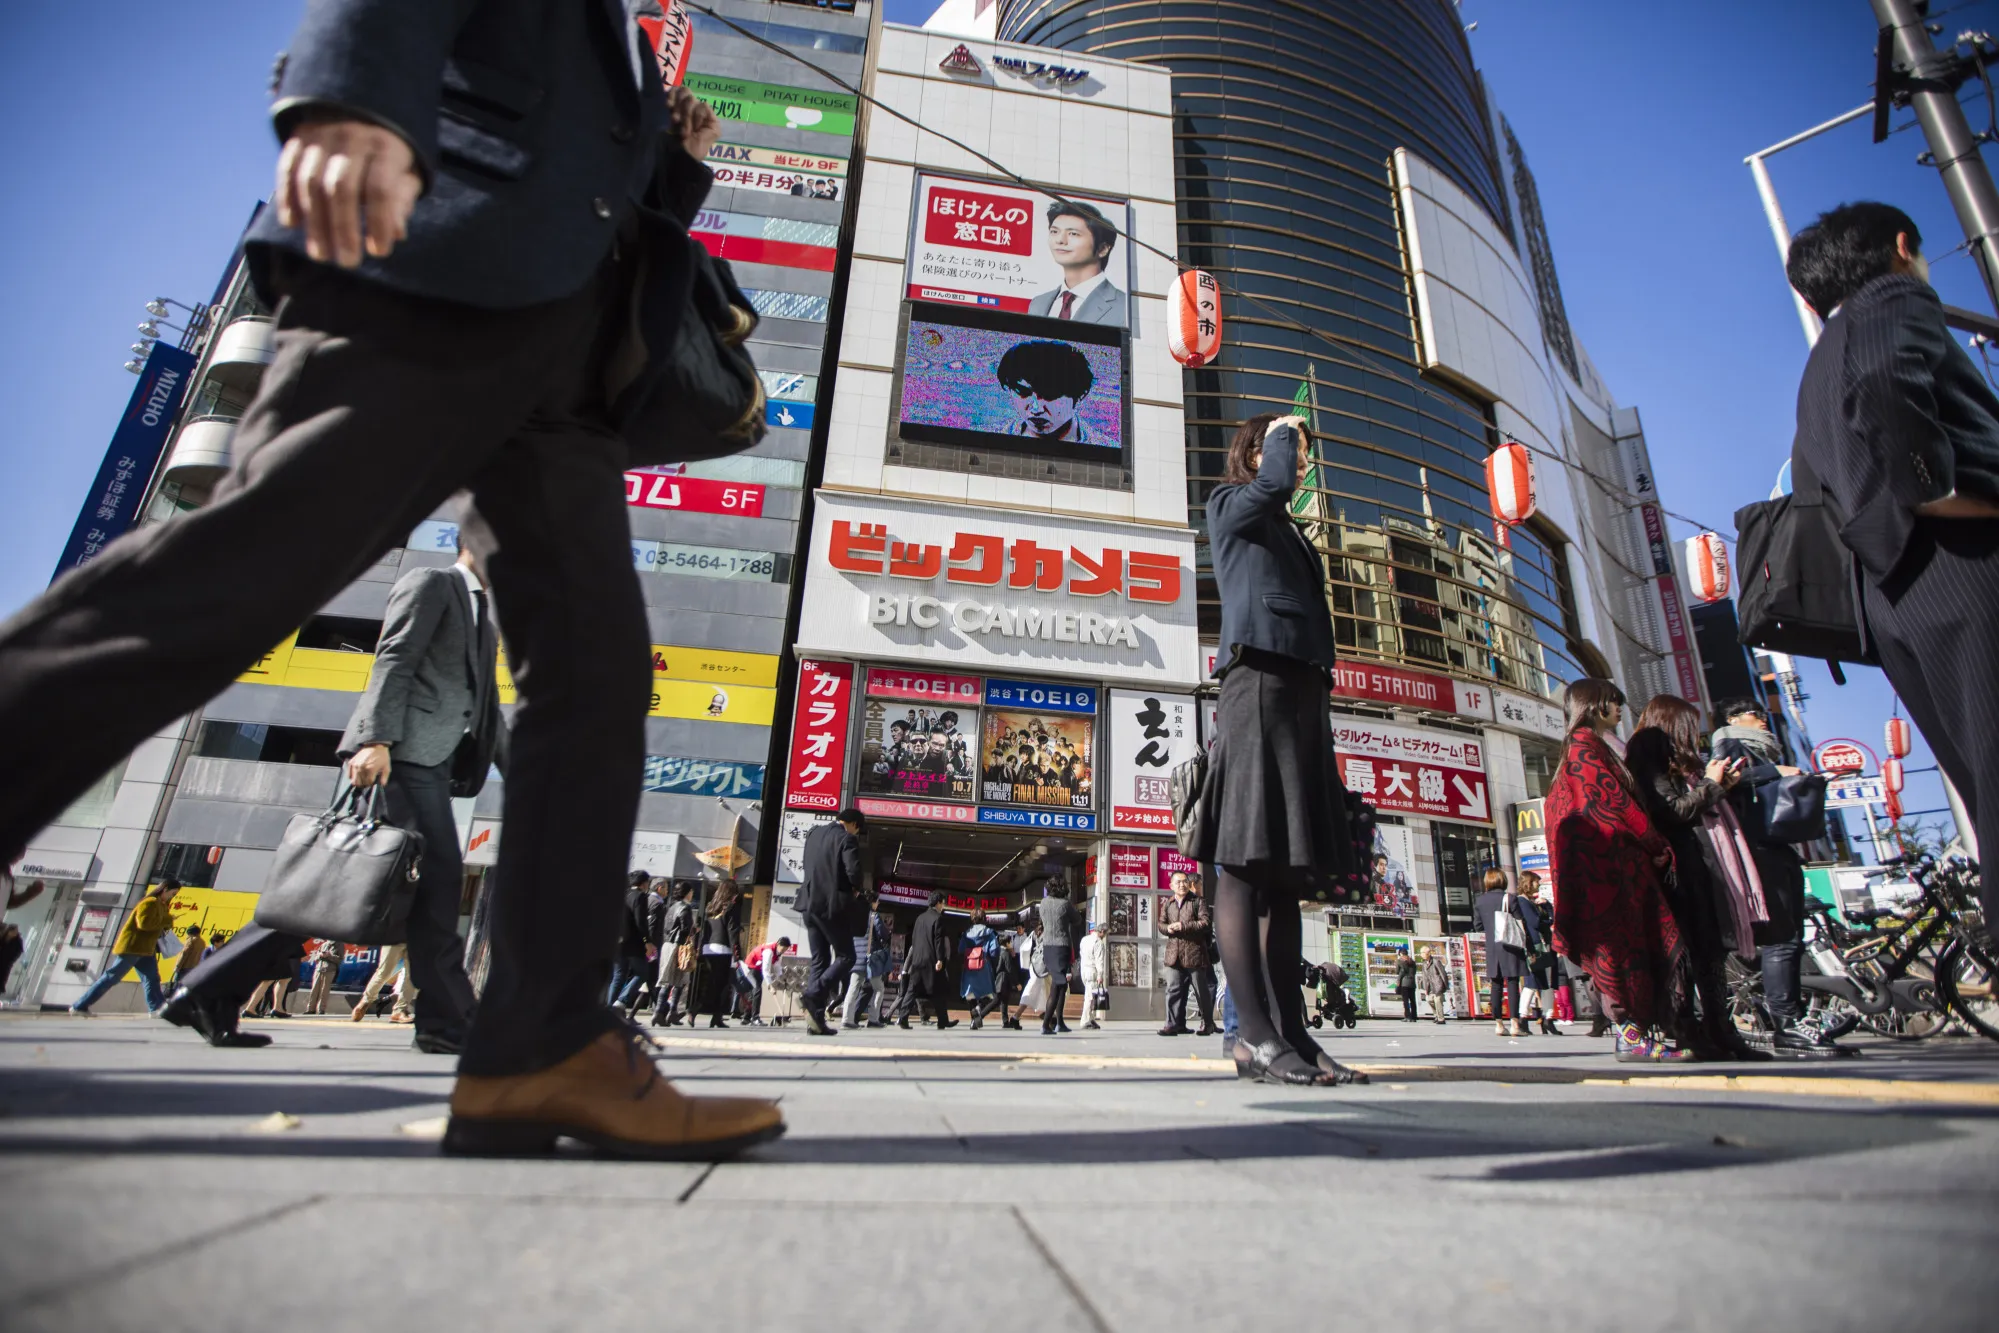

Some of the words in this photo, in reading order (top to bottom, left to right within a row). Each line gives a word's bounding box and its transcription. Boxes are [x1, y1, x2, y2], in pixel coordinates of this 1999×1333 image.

[697, 81, 746, 95] HOUSE
[763, 89, 800, 103] PITAT
[803, 94, 852, 110] HOUSE
[774, 154, 814, 168] 当ビル
[817, 160, 839, 170] 9F
[932, 196, 1029, 226] ほけんの
[953, 221, 1004, 246] 窓口
[923, 252, 1022, 272] あなたに寄り添う
[921, 264, 1038, 285] 保険選びのパートナー
[923, 290, 966, 301] ほけんの窓口
[141, 367, 181, 427] MIZUHO
[96, 456, 137, 521] みずほ証券
[720, 488, 759, 509] 5F
[645, 550, 773, 575] 03-5464-1788
[828, 520, 1182, 605] ビックカメラ
[868, 592, 942, 630] BIC
[952, 599, 1141, 649] CAMERA
[701, 664, 747, 673] 渋谷センター
[803, 662, 819, 671] 6F
[872, 678, 894, 688] 渋谷
[990, 688, 1012, 698] 渋谷
[1372, 674, 1437, 701] STATION
[1465, 691, 1482, 710] 1F
[799, 672, 841, 788] カラオケ
[1135, 697, 1170, 767] えん
[951, 781, 971, 792] 10.7
[1150, 780, 1169, 796] EN
[1344, 758, 1447, 803] 最大級
[788, 794, 808, 804] BIG
[809, 796, 837, 808] ECHO
[1013, 784, 1037, 803] FINAL
[1036, 787, 1071, 806] MISSION
[860, 802, 902, 813] SHIBUYA
[984, 811, 1025, 822] SHIBUYA
[893, 886, 908, 896] TAITO
